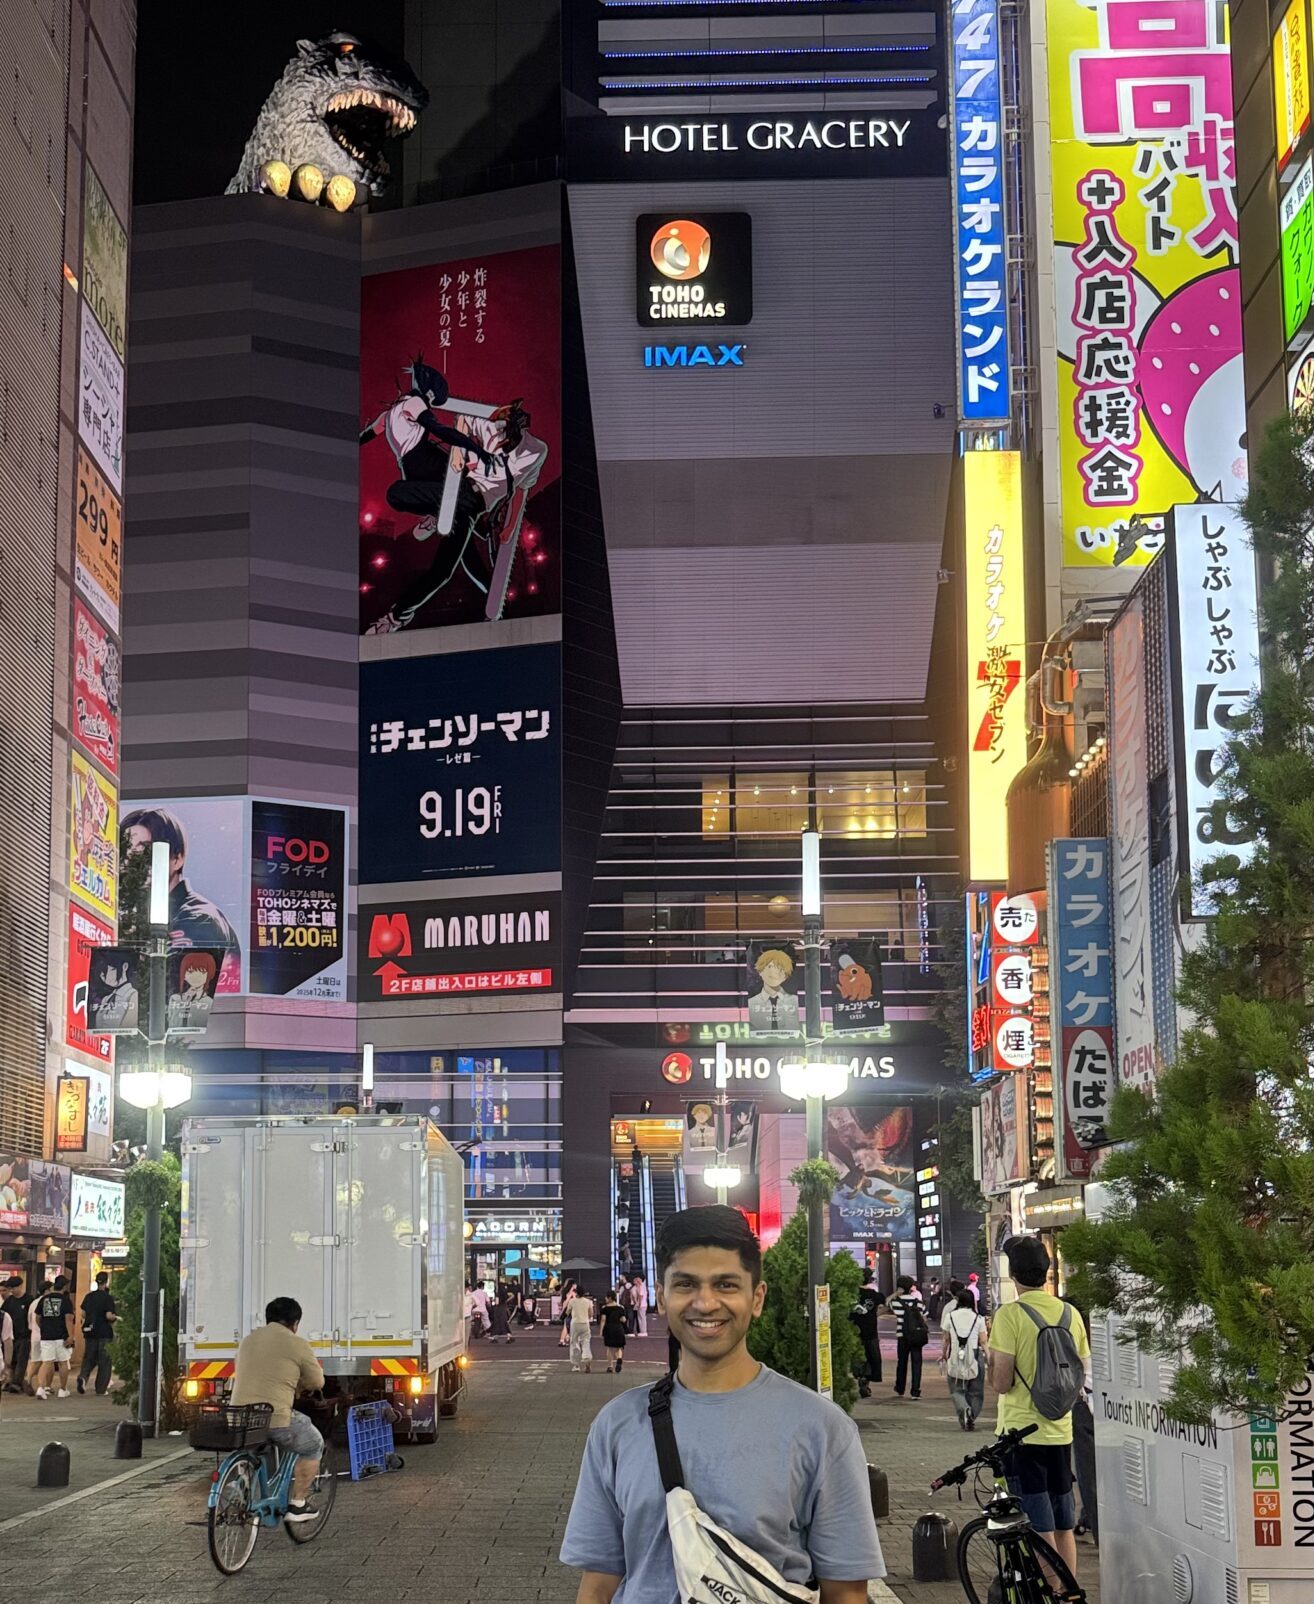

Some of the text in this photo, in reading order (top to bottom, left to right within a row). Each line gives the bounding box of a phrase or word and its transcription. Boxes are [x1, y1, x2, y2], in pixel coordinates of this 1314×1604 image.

[624, 119, 911, 153] HOTEL GRACERY
[1139, 140, 1181, 250] バイト
[960, 115, 1003, 403] カラオケランド
[83, 259, 123, 359] more
[457, 271, 472, 328] 少年と
[473, 267, 490, 344] 炸裂する
[649, 285, 705, 304] TOHO
[649, 302, 727, 320] CINEMAS
[643, 345, 745, 368] IMAX
[984, 524, 1006, 643] カラオケ
[1200, 514, 1236, 675] しゃぶしゃぶ
[379, 709, 551, 754] チェンソーマン
[419, 785, 503, 839] 9.19 FRI
[266, 836, 330, 864] FOD
[266, 861, 328, 879] フライデイ
[257, 897, 338, 911] TOHOシネマズで
[1000, 906, 1023, 929] 売
[424, 910, 550, 949] MARUHAN
[1063, 844, 1110, 1026] カラオケ
[389, 971, 542, 993] 2F店舗出入口はビル左側
[1001, 967, 1024, 990] 香
[1003, 1029, 1026, 1052] 煙
[1122, 1042, 1153, 1080] OPEN
[475, 1221, 545, 1232] ADORN
[838, 1206, 907, 1219] ヒックとドラゴン
[1101, 1391, 1134, 1427] Tourist
[1290, 1374, 1314, 1548] ORMATION
